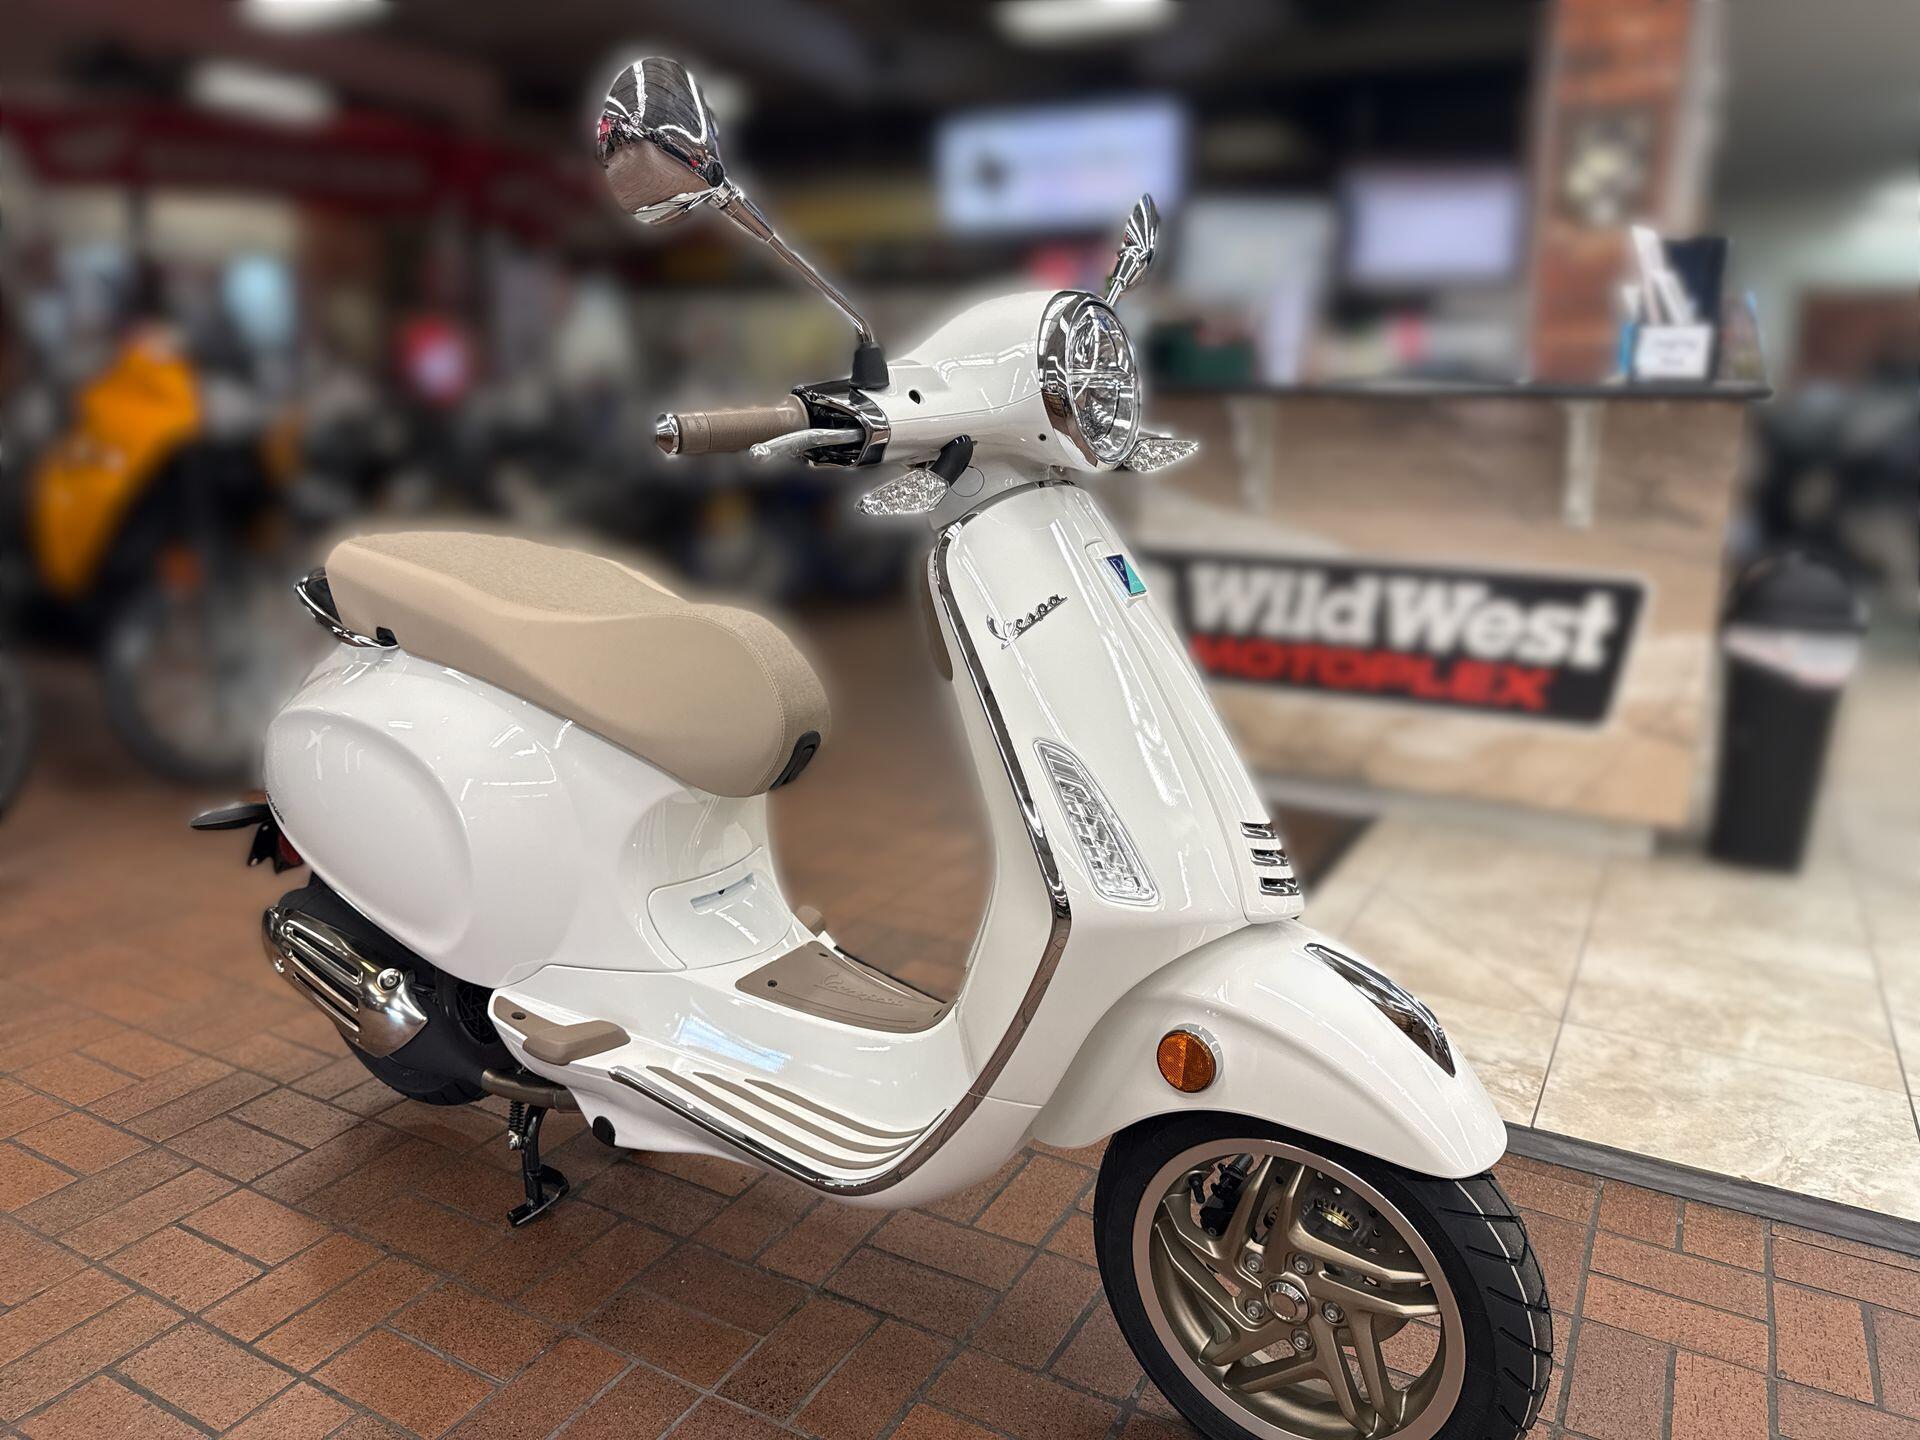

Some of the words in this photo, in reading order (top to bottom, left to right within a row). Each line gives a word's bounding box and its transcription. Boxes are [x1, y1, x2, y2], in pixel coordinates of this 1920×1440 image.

[986, 592, 1068, 650] Vespa
[1191, 567, 1377, 645] Wild
[1383, 575, 1617, 669] West
[1190, 634, 1553, 711] MOTOPLEX
